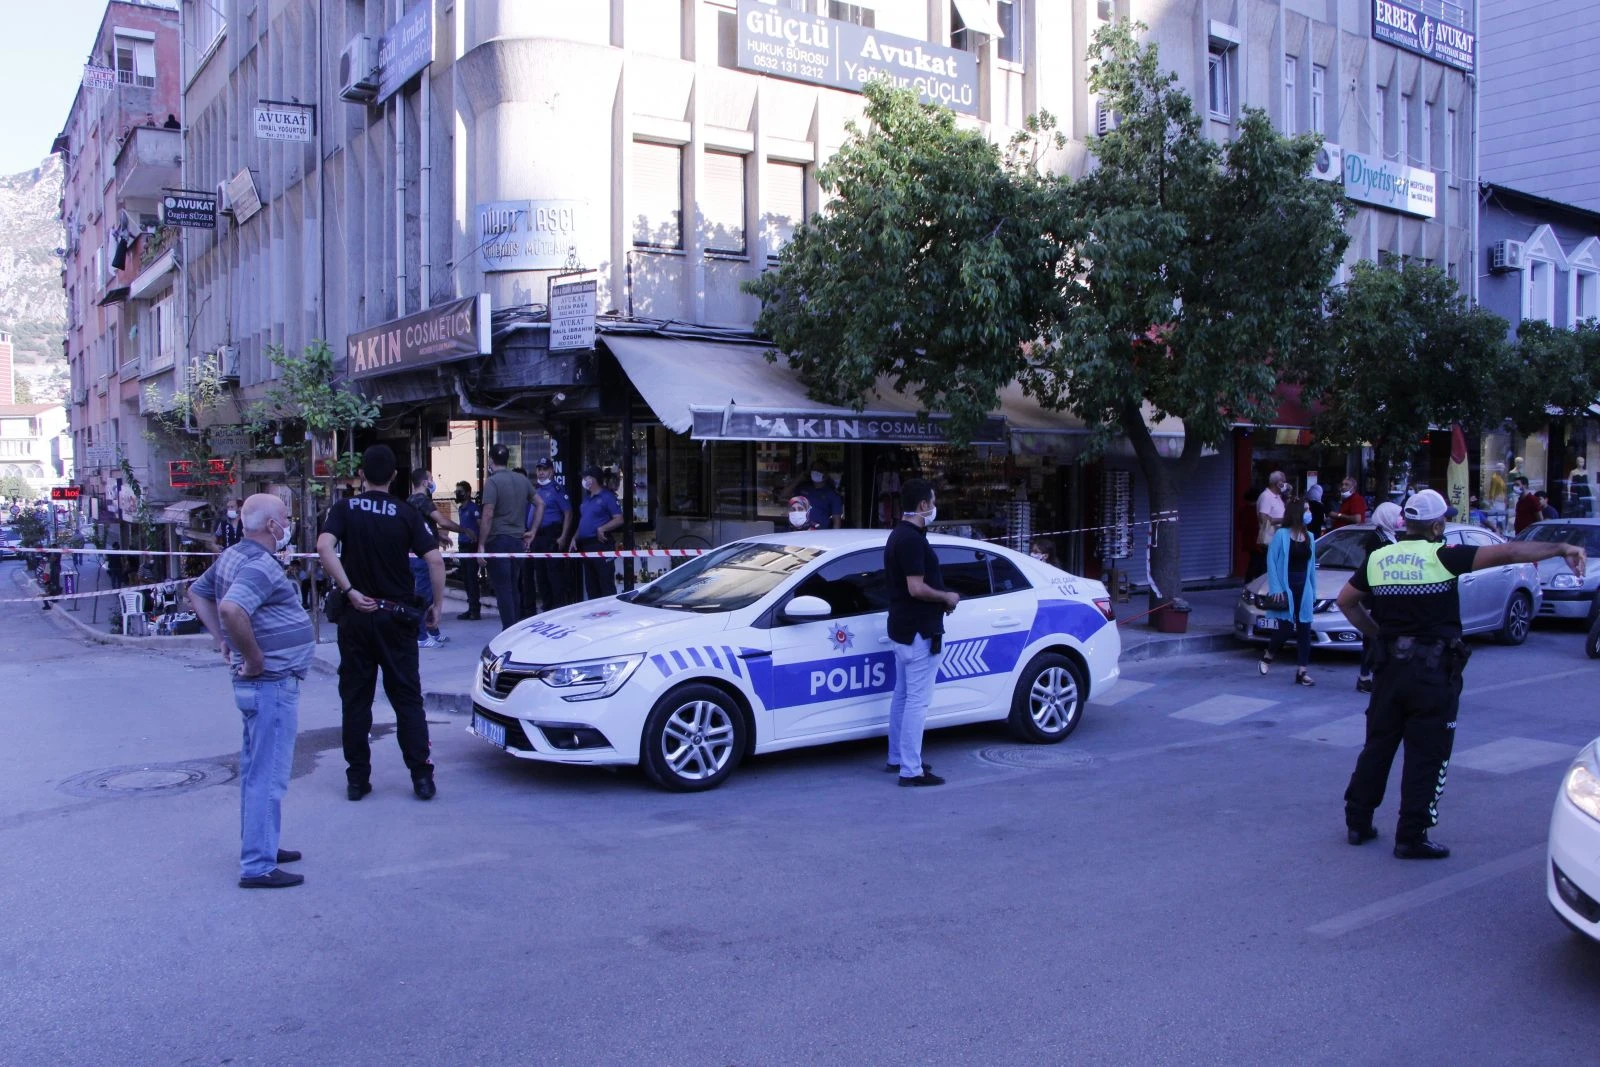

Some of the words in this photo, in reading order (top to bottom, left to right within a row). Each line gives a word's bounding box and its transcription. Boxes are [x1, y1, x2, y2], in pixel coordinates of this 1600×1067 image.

[1376, 0, 1417, 35] ERBEK
[1435, 22, 1474, 53] AVUKAT
[747, 39, 784, 57] HUKUK
[786, 47, 829, 66] BÜROSU
[860, 35, 958, 78] Avukat
[753, 54, 778, 69] 0532
[781, 61, 797, 73] 131
[800, 64, 823, 79] 3212
[914, 76, 972, 105] GÜÇLÜ
[258, 112, 307, 126] AVUKAT
[1346, 154, 1409, 203] Diyetisyen
[177, 199, 214, 212] AVUKAT
[189, 211, 214, 221] SÜZER
[560, 318, 585, 327] AVUKAT
[354, 329, 402, 373] AKIN
[405, 309, 471, 348] COSMETICS
[768, 417, 859, 438] AKIN
[349, 498, 397, 516] POLİS
[1377, 552, 1426, 570] TRAFİK
[1383, 570, 1423, 581] POLİSİ
[1058, 584, 1078, 596] 112
[810, 657, 886, 696] POLİS
